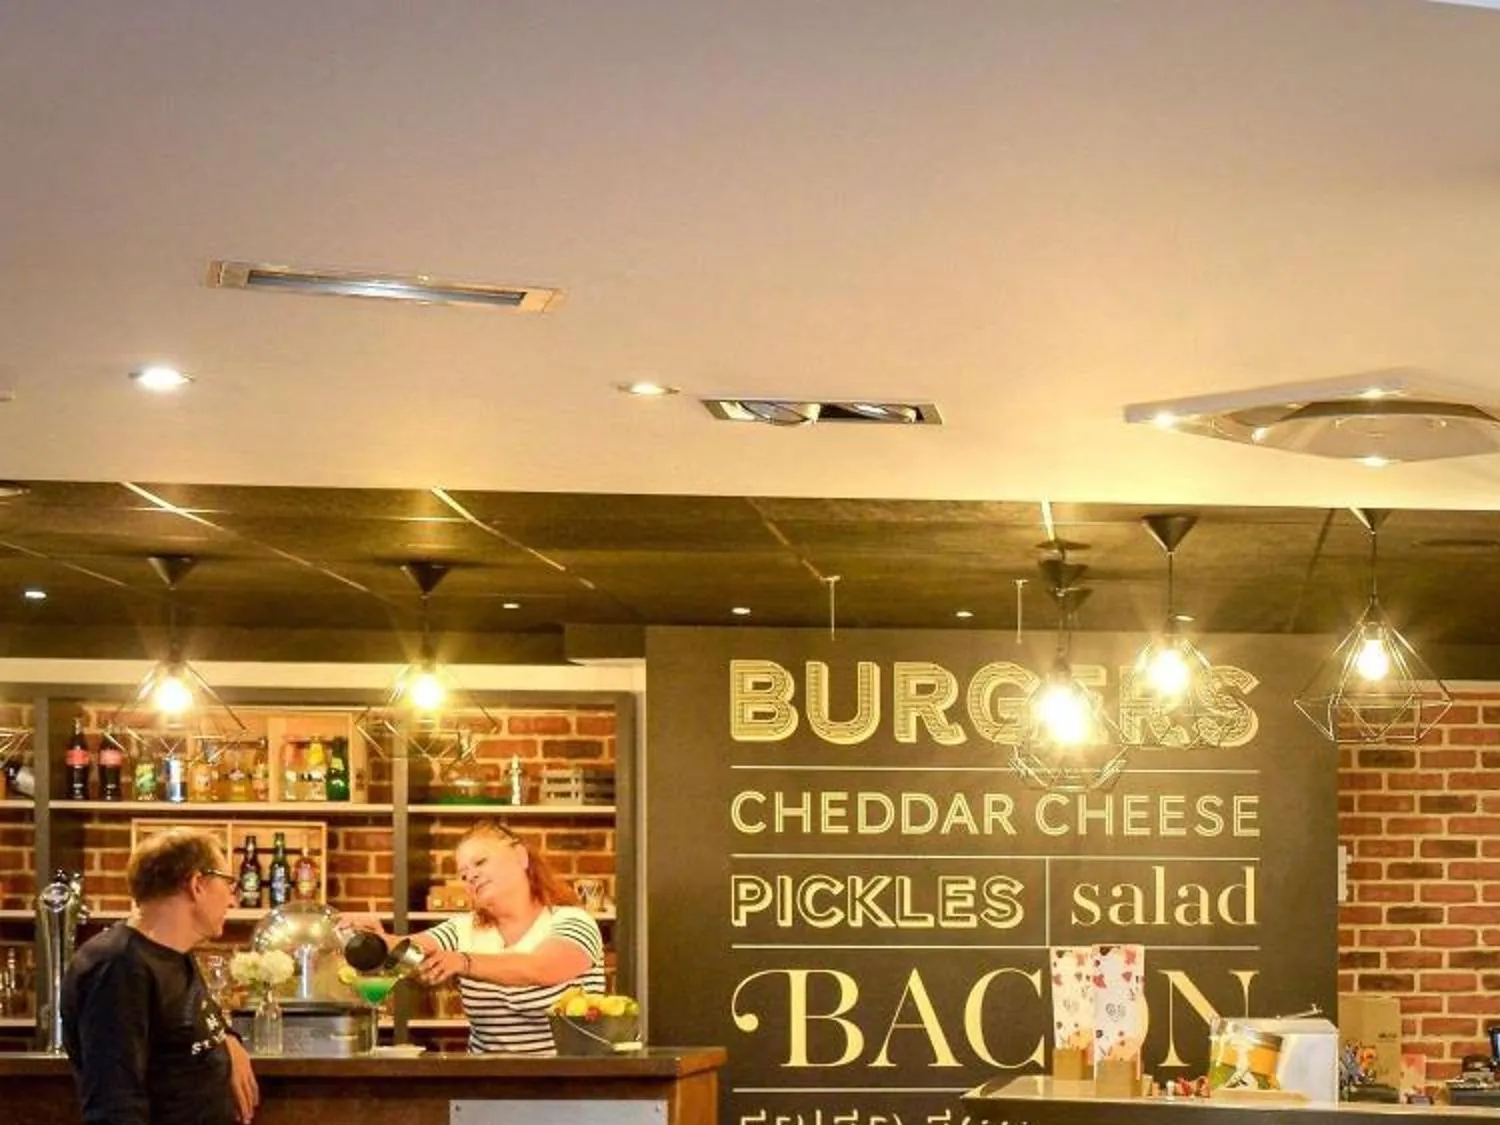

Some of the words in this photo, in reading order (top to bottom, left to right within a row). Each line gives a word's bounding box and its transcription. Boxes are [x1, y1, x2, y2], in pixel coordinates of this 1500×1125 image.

[731, 791, 1017, 836] CHEDDAR
[1035, 794, 1260, 837] CHEESE
[731, 874, 1025, 929] PICKLES
[1071, 866, 1257, 927] salad
[731, 968, 1260, 1069] BACN
